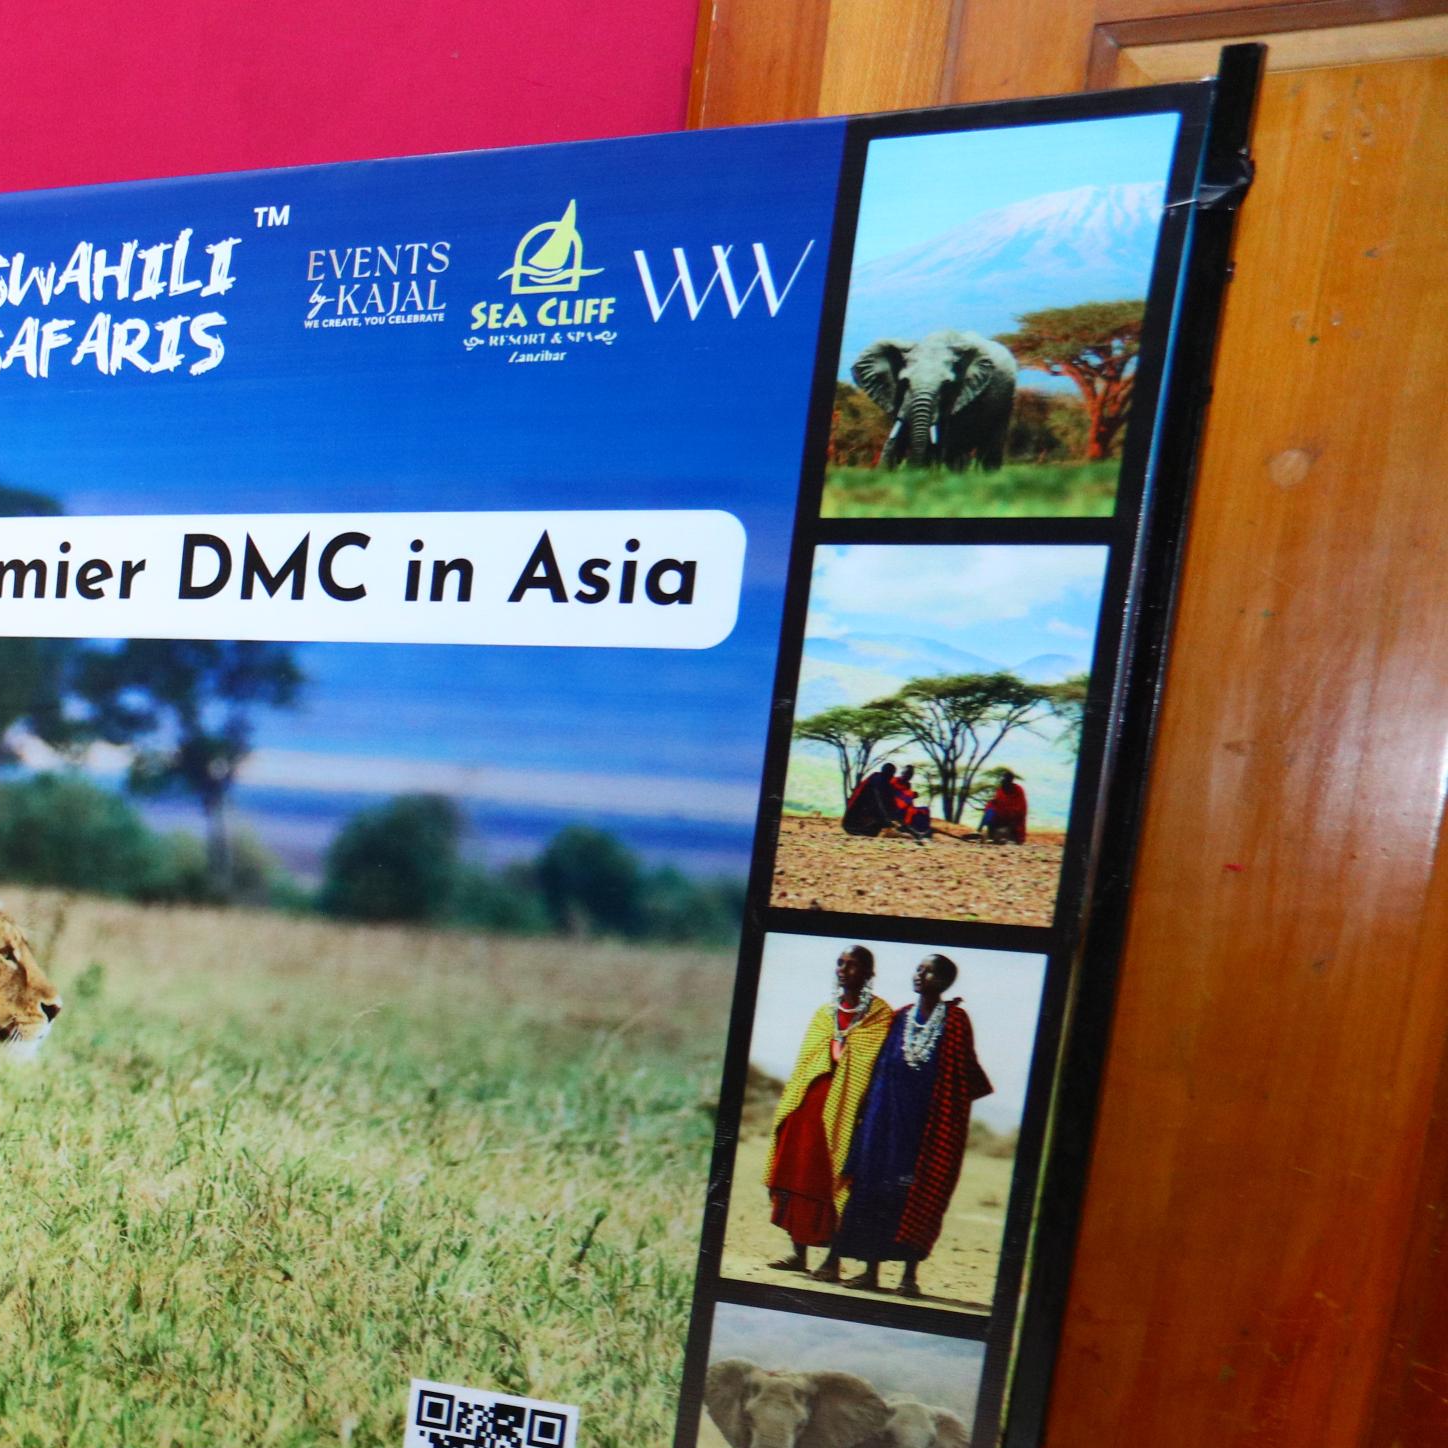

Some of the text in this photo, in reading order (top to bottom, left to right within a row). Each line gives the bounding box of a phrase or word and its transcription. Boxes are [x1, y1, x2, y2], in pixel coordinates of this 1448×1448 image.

[254, 205, 291, 228] TM
[307, 241, 451, 281] EVENTS
[307, 280, 447, 319] by KAJAL
[470, 297, 616, 330] SEA CLIFF
[304, 313, 445, 329] WE CREATE, YOU CELEBRATE
[489, 332, 546, 346] RESORT
[550, 332, 562, 344] &
[177, 529, 372, 602] DMC
[404, 537, 475, 603] in
[507, 529, 698, 606] Asia
